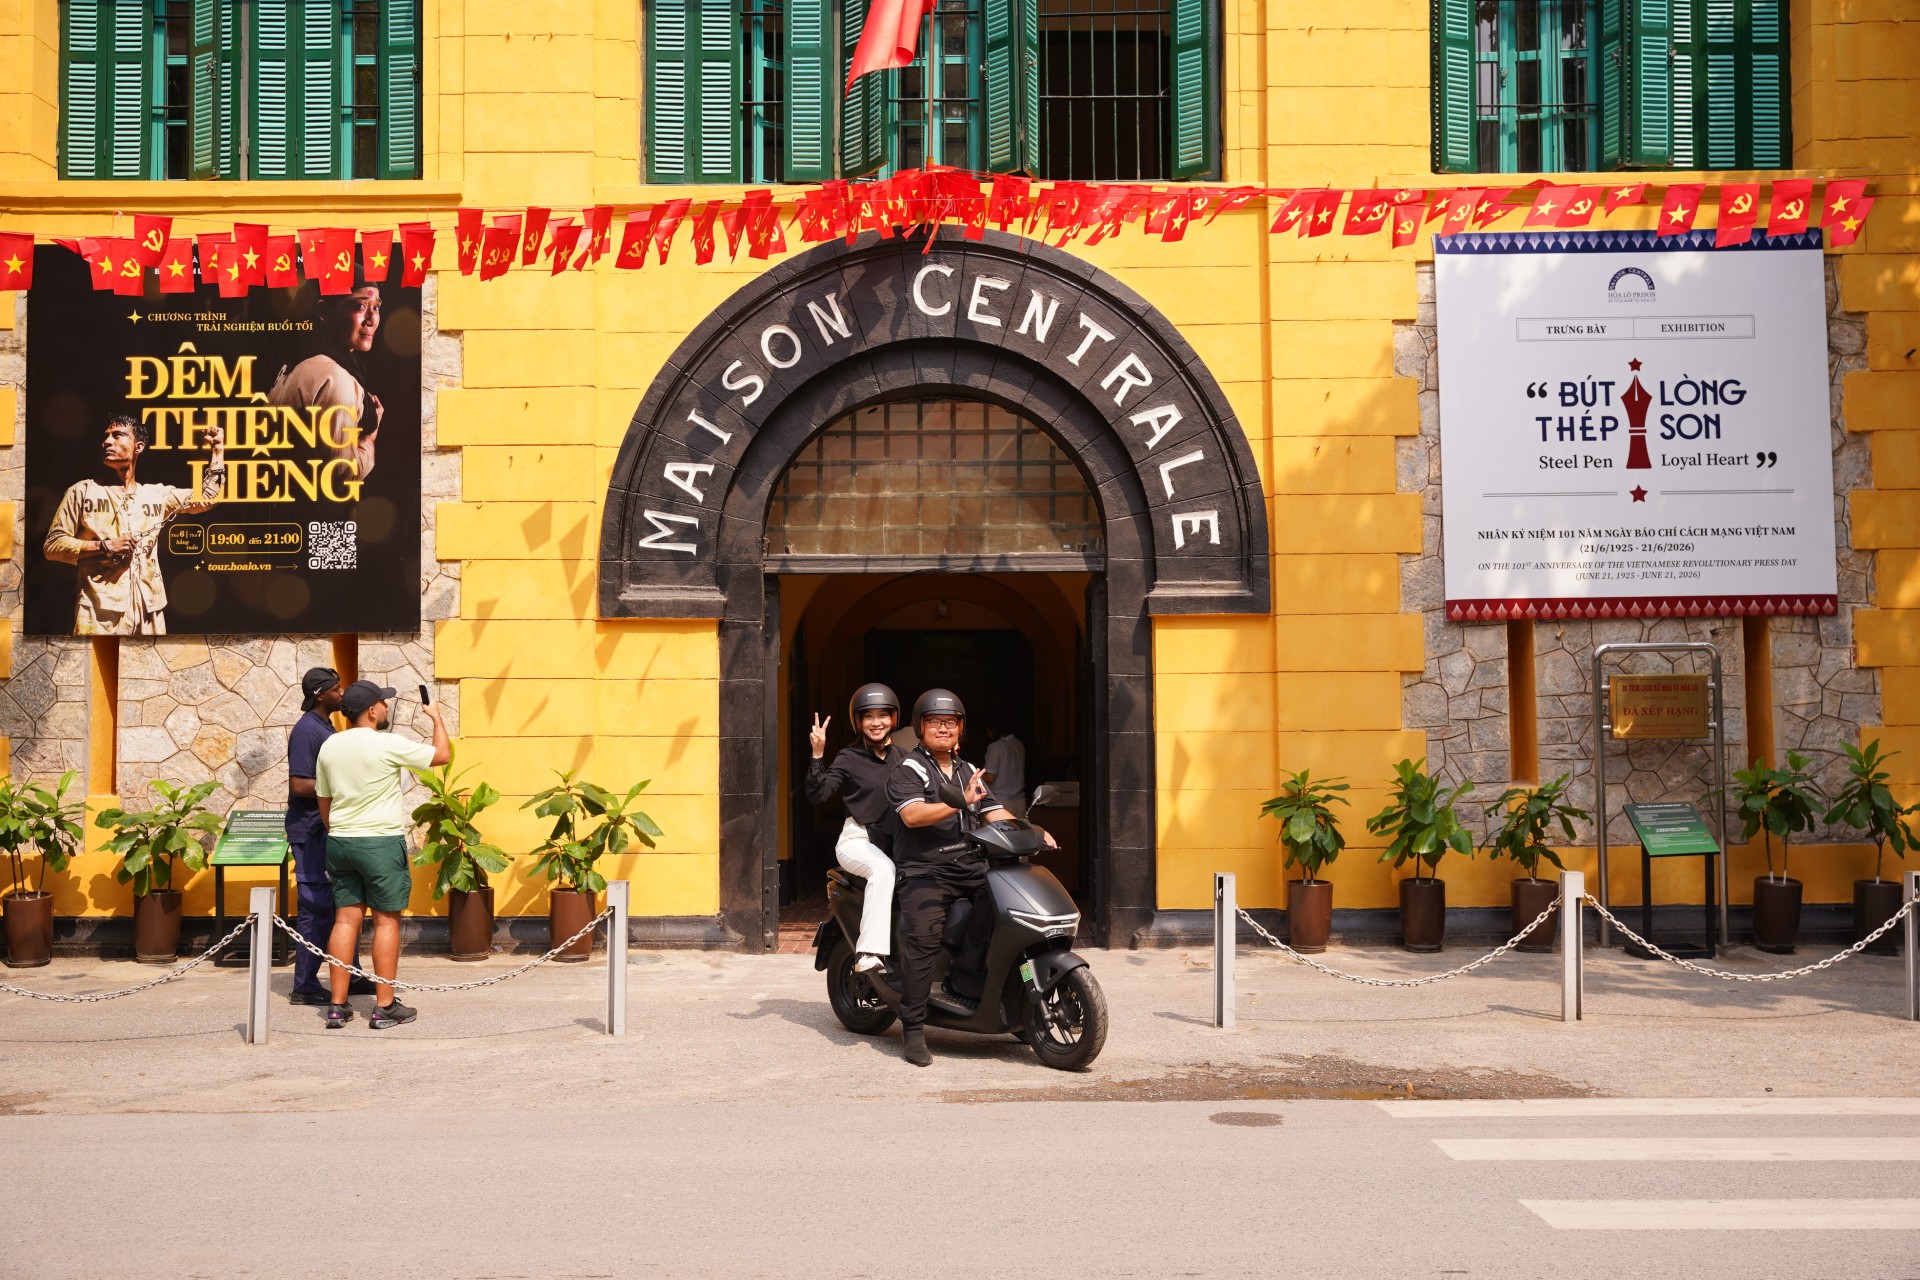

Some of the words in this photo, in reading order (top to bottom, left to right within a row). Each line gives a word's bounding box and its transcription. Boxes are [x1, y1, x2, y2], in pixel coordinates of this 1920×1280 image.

[147, 312, 192, 322] CHƯƠNG
[193, 312, 227, 321] TRÌNH
[196, 320, 221, 332] TRẢI
[223, 321, 265, 333] NGHIỆM
[267, 319, 293, 331] BUỔI
[295, 320, 314, 331] TỐI
[1546, 323, 1584, 335] TRƯNG
[1586, 323, 1607, 334] BÀY
[1660, 322, 1726, 333] EXHIBITION
[124, 341, 258, 399] ĐÊM
[1659, 373, 1747, 406] LÒNG
[639, 292, 852, 556] MAISON
[912, 264, 1221, 550] CENTRALE
[141, 392, 364, 450] THIÊNG
[1535, 409, 1619, 442] THÉP
[1659, 413, 1721, 440] SON
[1539, 454, 1579, 469] Steel
[1583, 455, 1613, 469] Pen
[1661, 453, 1702, 470] Loyal
[1706, 452, 1749, 467] Heart
[186, 446, 364, 503] LIÊNG
[179, 530, 185, 538] 6
[210, 533, 245, 545] 19:00
[263, 533, 300, 545] 21:00
[1477, 529, 1509, 540] NHÂN
[1528, 528, 1555, 541] NIỆM
[1558, 530, 1576, 538] 101
[1578, 528, 1602, 538] NĂM
[1605, 527, 1633, 538] NGÀY
[1634, 527, 1656, 537] BÁO
[1658, 527, 1677, 537] CHÍ
[1679, 526, 1708, 537] CÁCH
[1710, 527, 1742, 539] MẠNG
[1744, 525, 1769, 538] VIỆT
[1771, 527, 1796, 535] NAM
[1579, 544, 1633, 554] (21/6/1925
[1641, 543, 1695, 553] 21/6/2026)
[207, 562, 272, 572] tour.hoalo.vn
[1478, 563, 1490, 571] ON
[1493, 562, 1510, 570] THE
[1594, 561, 1606, 569] OF
[1607, 561, 1625, 569] THE
[1627, 560, 1681, 569] VIETNAMESE
[1682, 559, 1752, 568] REVOLUTIONARY
[1754, 559, 1779, 567] PRESS
[1781, 558, 1798, 567] DAY
[1575, 572, 1600, 580] (JUNE
[1601, 572, 1614, 580] 21,
[1616, 572, 1635, 580] 1925
[1641, 571, 1663, 580] JUNE
[1664, 571, 1676, 580] 21,
[1678, 571, 1701, 579] 2026)
